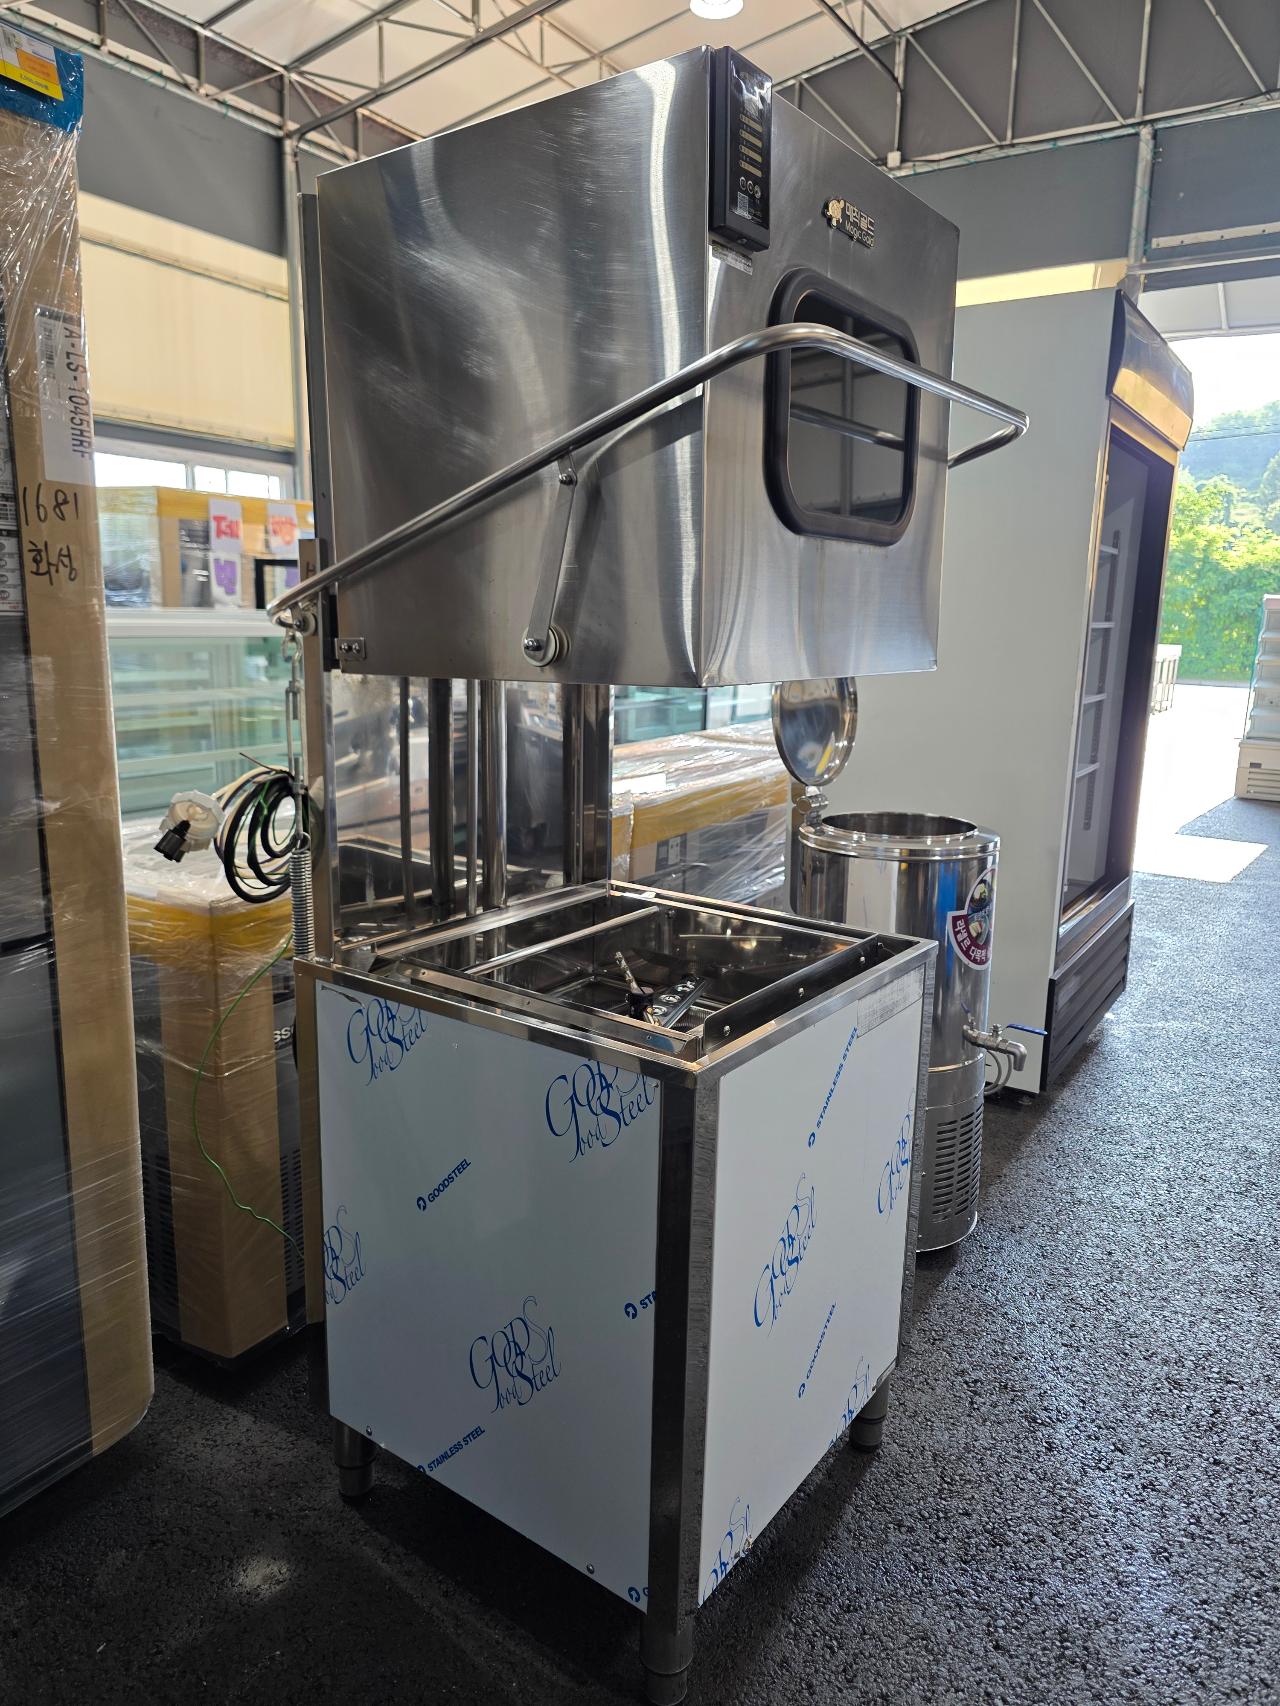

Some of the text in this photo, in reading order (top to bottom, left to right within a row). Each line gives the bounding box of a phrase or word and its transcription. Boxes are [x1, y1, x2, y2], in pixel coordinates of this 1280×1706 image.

[23, 483, 80, 527] 1681
[816, 1026, 858, 1128] STAINLESS STEEL
[428, 1158, 471, 1203] GOODSTEEL
[427, 1425, 486, 1472] STAINLESS STEEL
